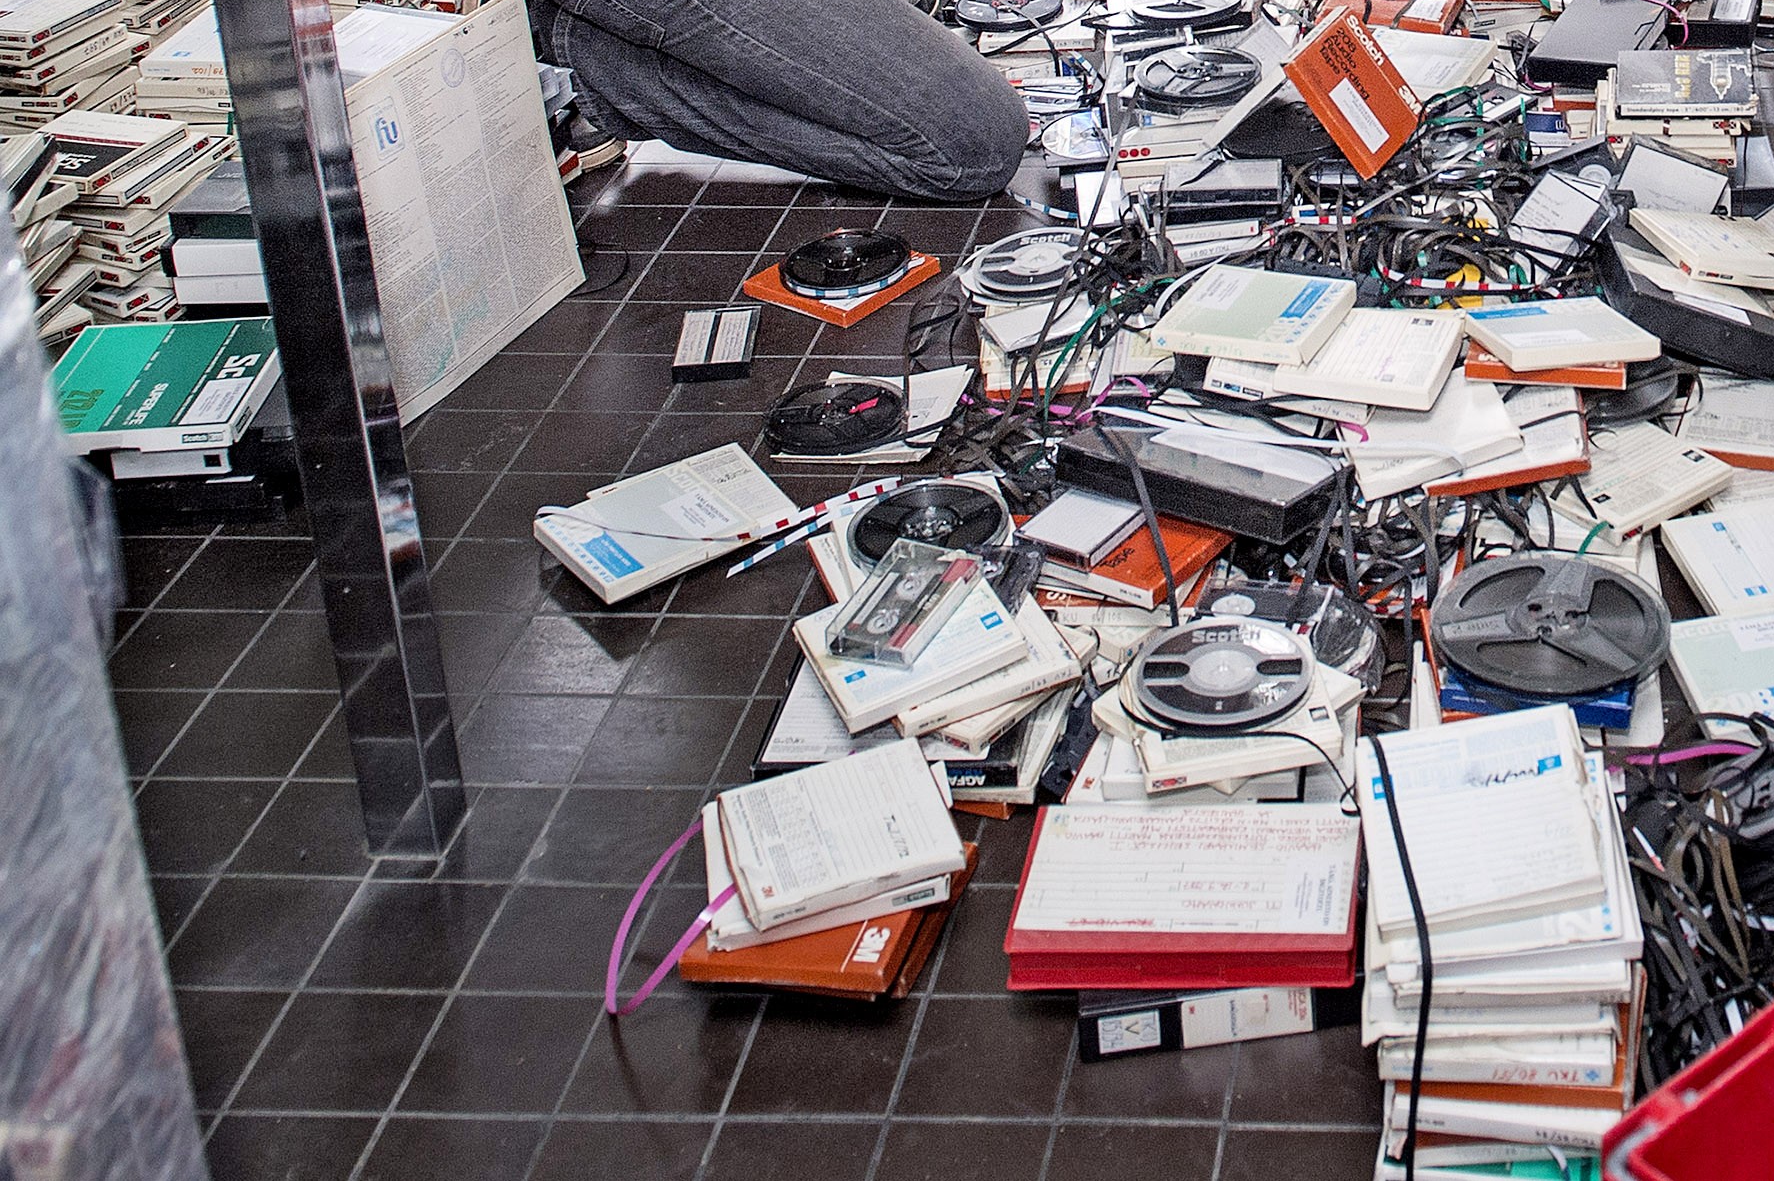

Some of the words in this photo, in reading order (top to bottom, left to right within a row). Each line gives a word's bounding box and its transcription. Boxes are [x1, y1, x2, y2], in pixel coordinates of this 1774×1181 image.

[1329, 33, 1358, 70] Audio
[1335, 26, 1357, 54] 208
[1346, 14, 1385, 67] Scotch
[1318, 45, 1342, 76] Tape
[1323, 35, 1370, 101] Recording
[1398, 84, 1424, 116] 3M
[1020, 234, 1071, 247] Scotch
[183, 433, 208, 443] Scotch
[951, 775, 986, 788] AGFA
[852, 926, 892, 963] 3M
